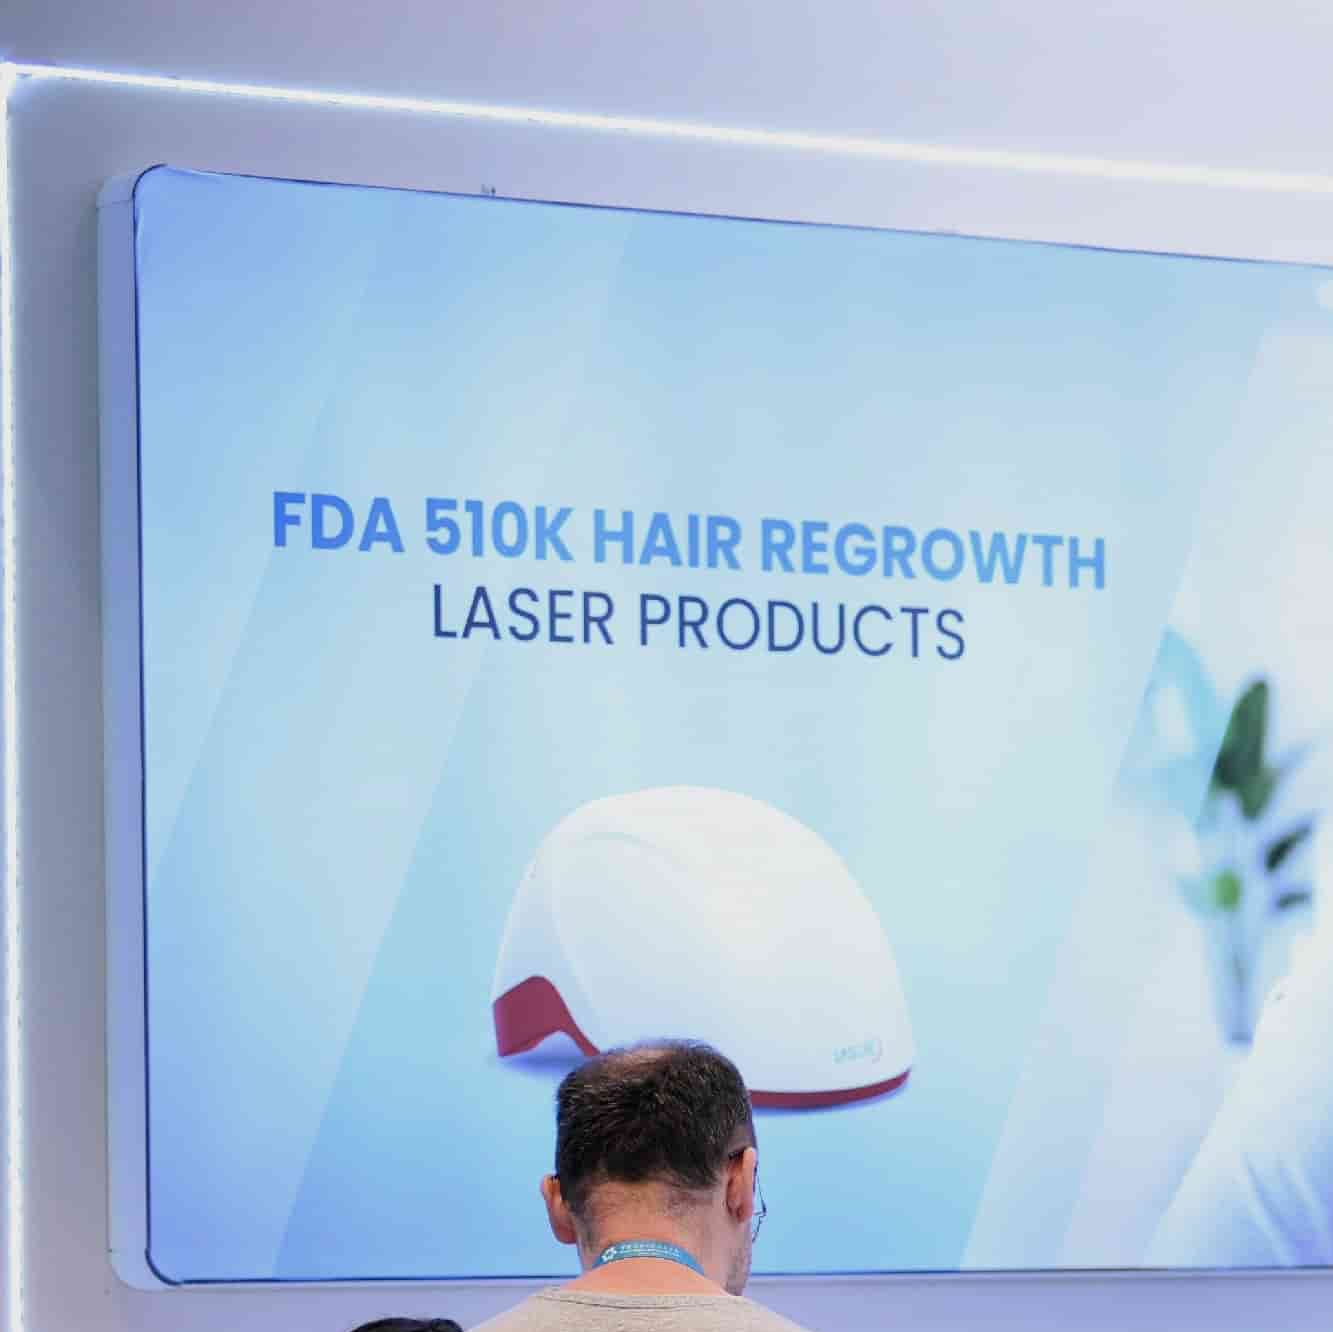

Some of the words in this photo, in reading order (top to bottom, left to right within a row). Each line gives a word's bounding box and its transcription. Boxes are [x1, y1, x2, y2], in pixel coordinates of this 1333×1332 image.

[273, 491, 405, 553] FDA
[425, 497, 574, 562] 510K
[593, 508, 742, 572] HAIR
[761, 517, 1106, 590] REGROWTH
[433, 583, 614, 645] LASER
[640, 593, 965, 660] PRODUCTS
